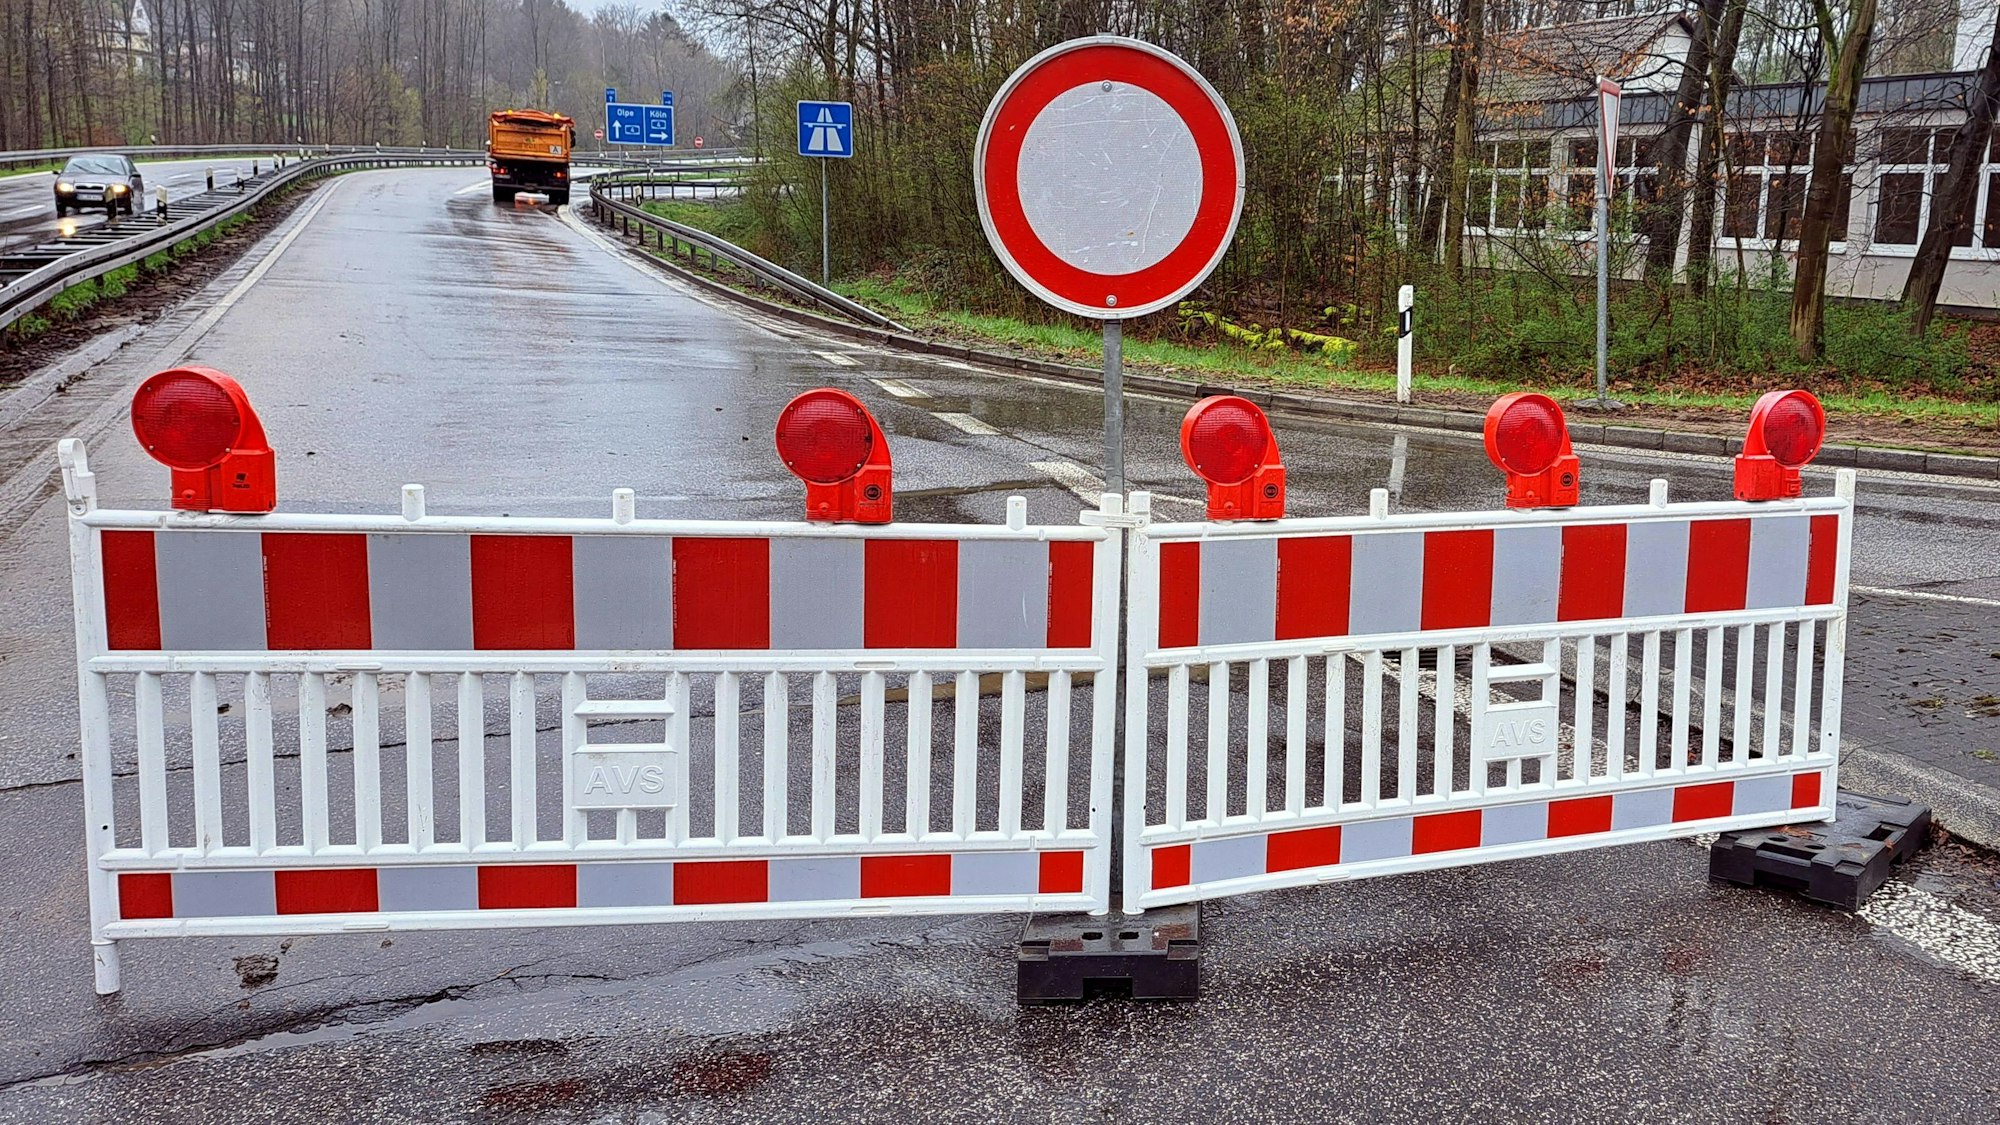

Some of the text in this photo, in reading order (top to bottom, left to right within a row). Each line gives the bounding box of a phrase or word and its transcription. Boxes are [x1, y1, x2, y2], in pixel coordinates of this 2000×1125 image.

[616, 108, 634, 118] Olpe
[649, 110, 667, 118] Köln
[1490, 718, 1546, 748] AVS
[584, 765, 664, 795] AVS
